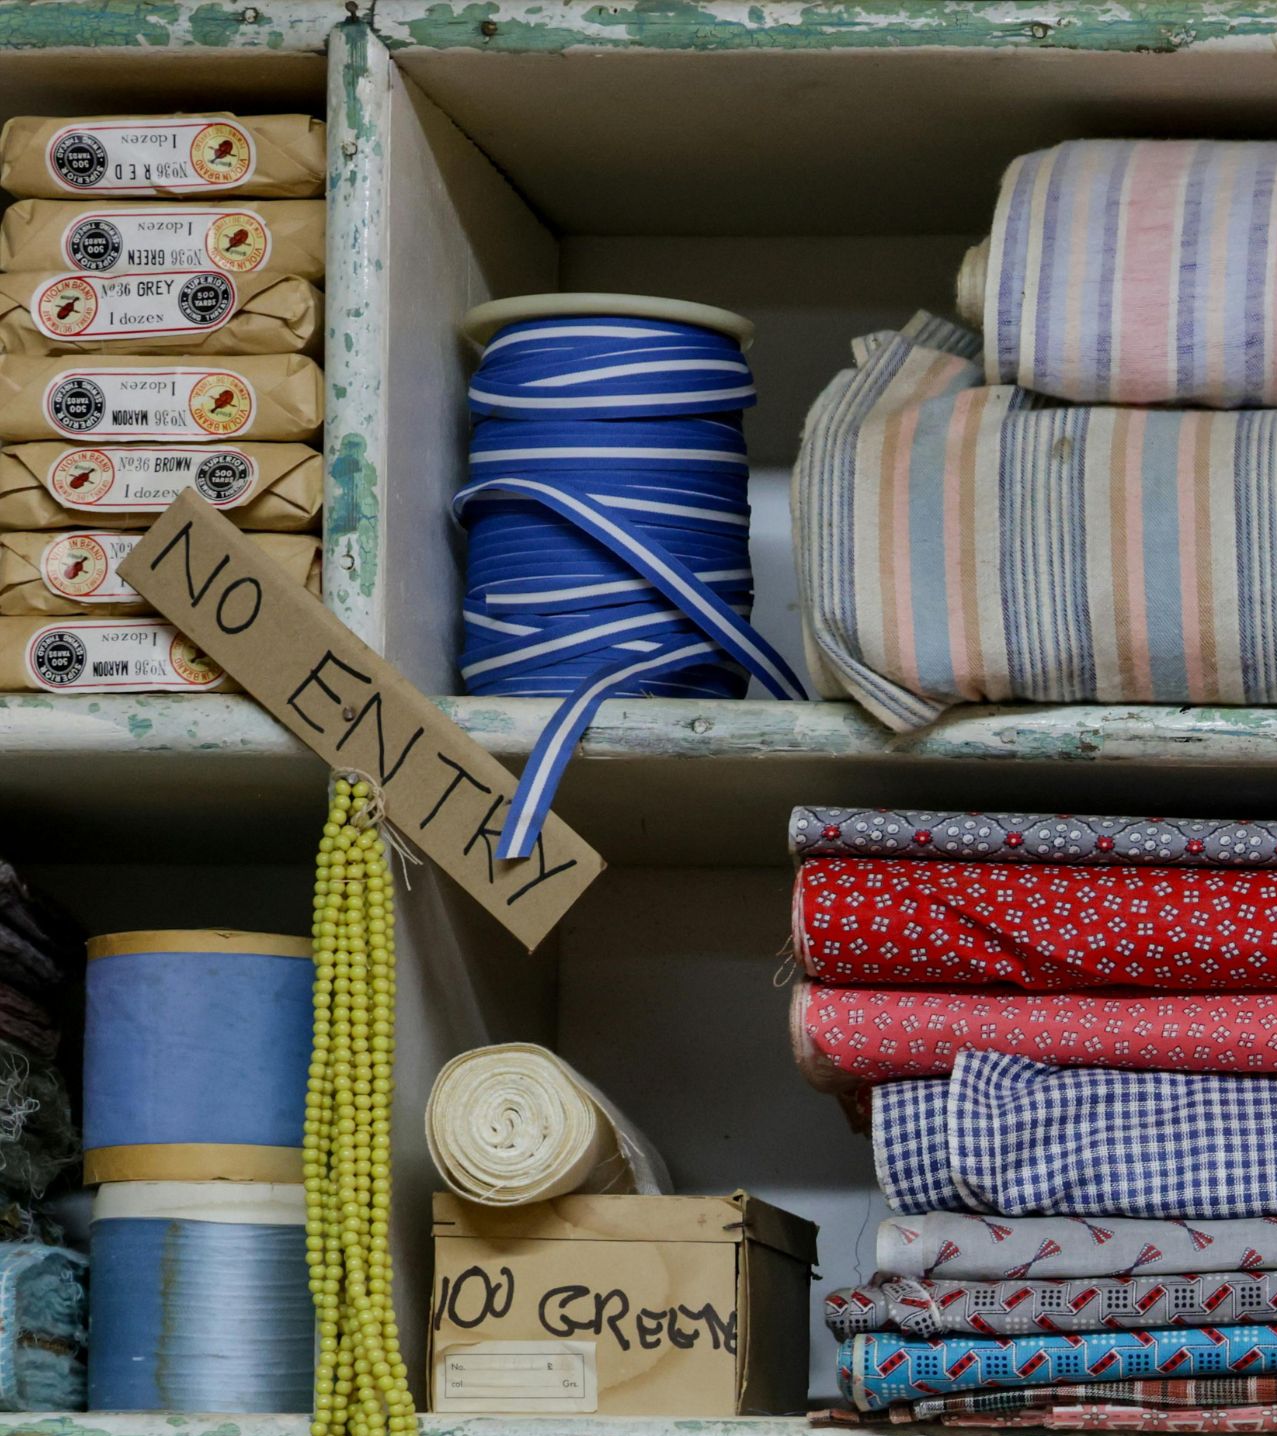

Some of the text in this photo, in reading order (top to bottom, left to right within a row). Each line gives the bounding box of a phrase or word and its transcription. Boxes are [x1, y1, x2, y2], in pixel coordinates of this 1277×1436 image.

[121, 133, 177, 149] 1 dozen
[68, 152, 91, 160] YARDS
[72, 160, 89, 168] 500
[60, 166, 105, 186] SUPERIOR
[115, 163, 151, 181] RED
[194, 159, 221, 181] BRAND
[138, 221, 192, 236] 1 dozen
[87, 245, 104, 254] 500
[128, 249, 165, 266] GREEN
[75, 251, 118, 270] SUPERIOR
[137, 279, 174, 297] GREY
[185, 275, 226, 294] SUPERIOR
[197, 291, 214, 299] 500
[110, 311, 164, 325] 1 dozen
[120, 381, 176, 396] 1 dozen
[67, 397, 90, 405] YARDS
[69, 405, 87, 413] 500
[57, 411, 101, 430] SUPERIOR
[112, 409, 148, 426] MAROON
[194, 408, 221, 431] BRAND
[154, 456, 192, 473] BROWN
[202, 455, 245, 472] SUPERIOR
[215, 469, 232, 477] 500
[124, 483, 179, 498] 1 dozen
[80, 539, 102, 561] BRAND
[150, 520, 263, 636] NO
[102, 631, 158, 646] 1 dozen
[48, 650, 71, 658] YARDS
[51, 658, 68, 666] 500
[39, 664, 81, 682] SUPERIOR
[92, 660, 129, 677] MAROON
